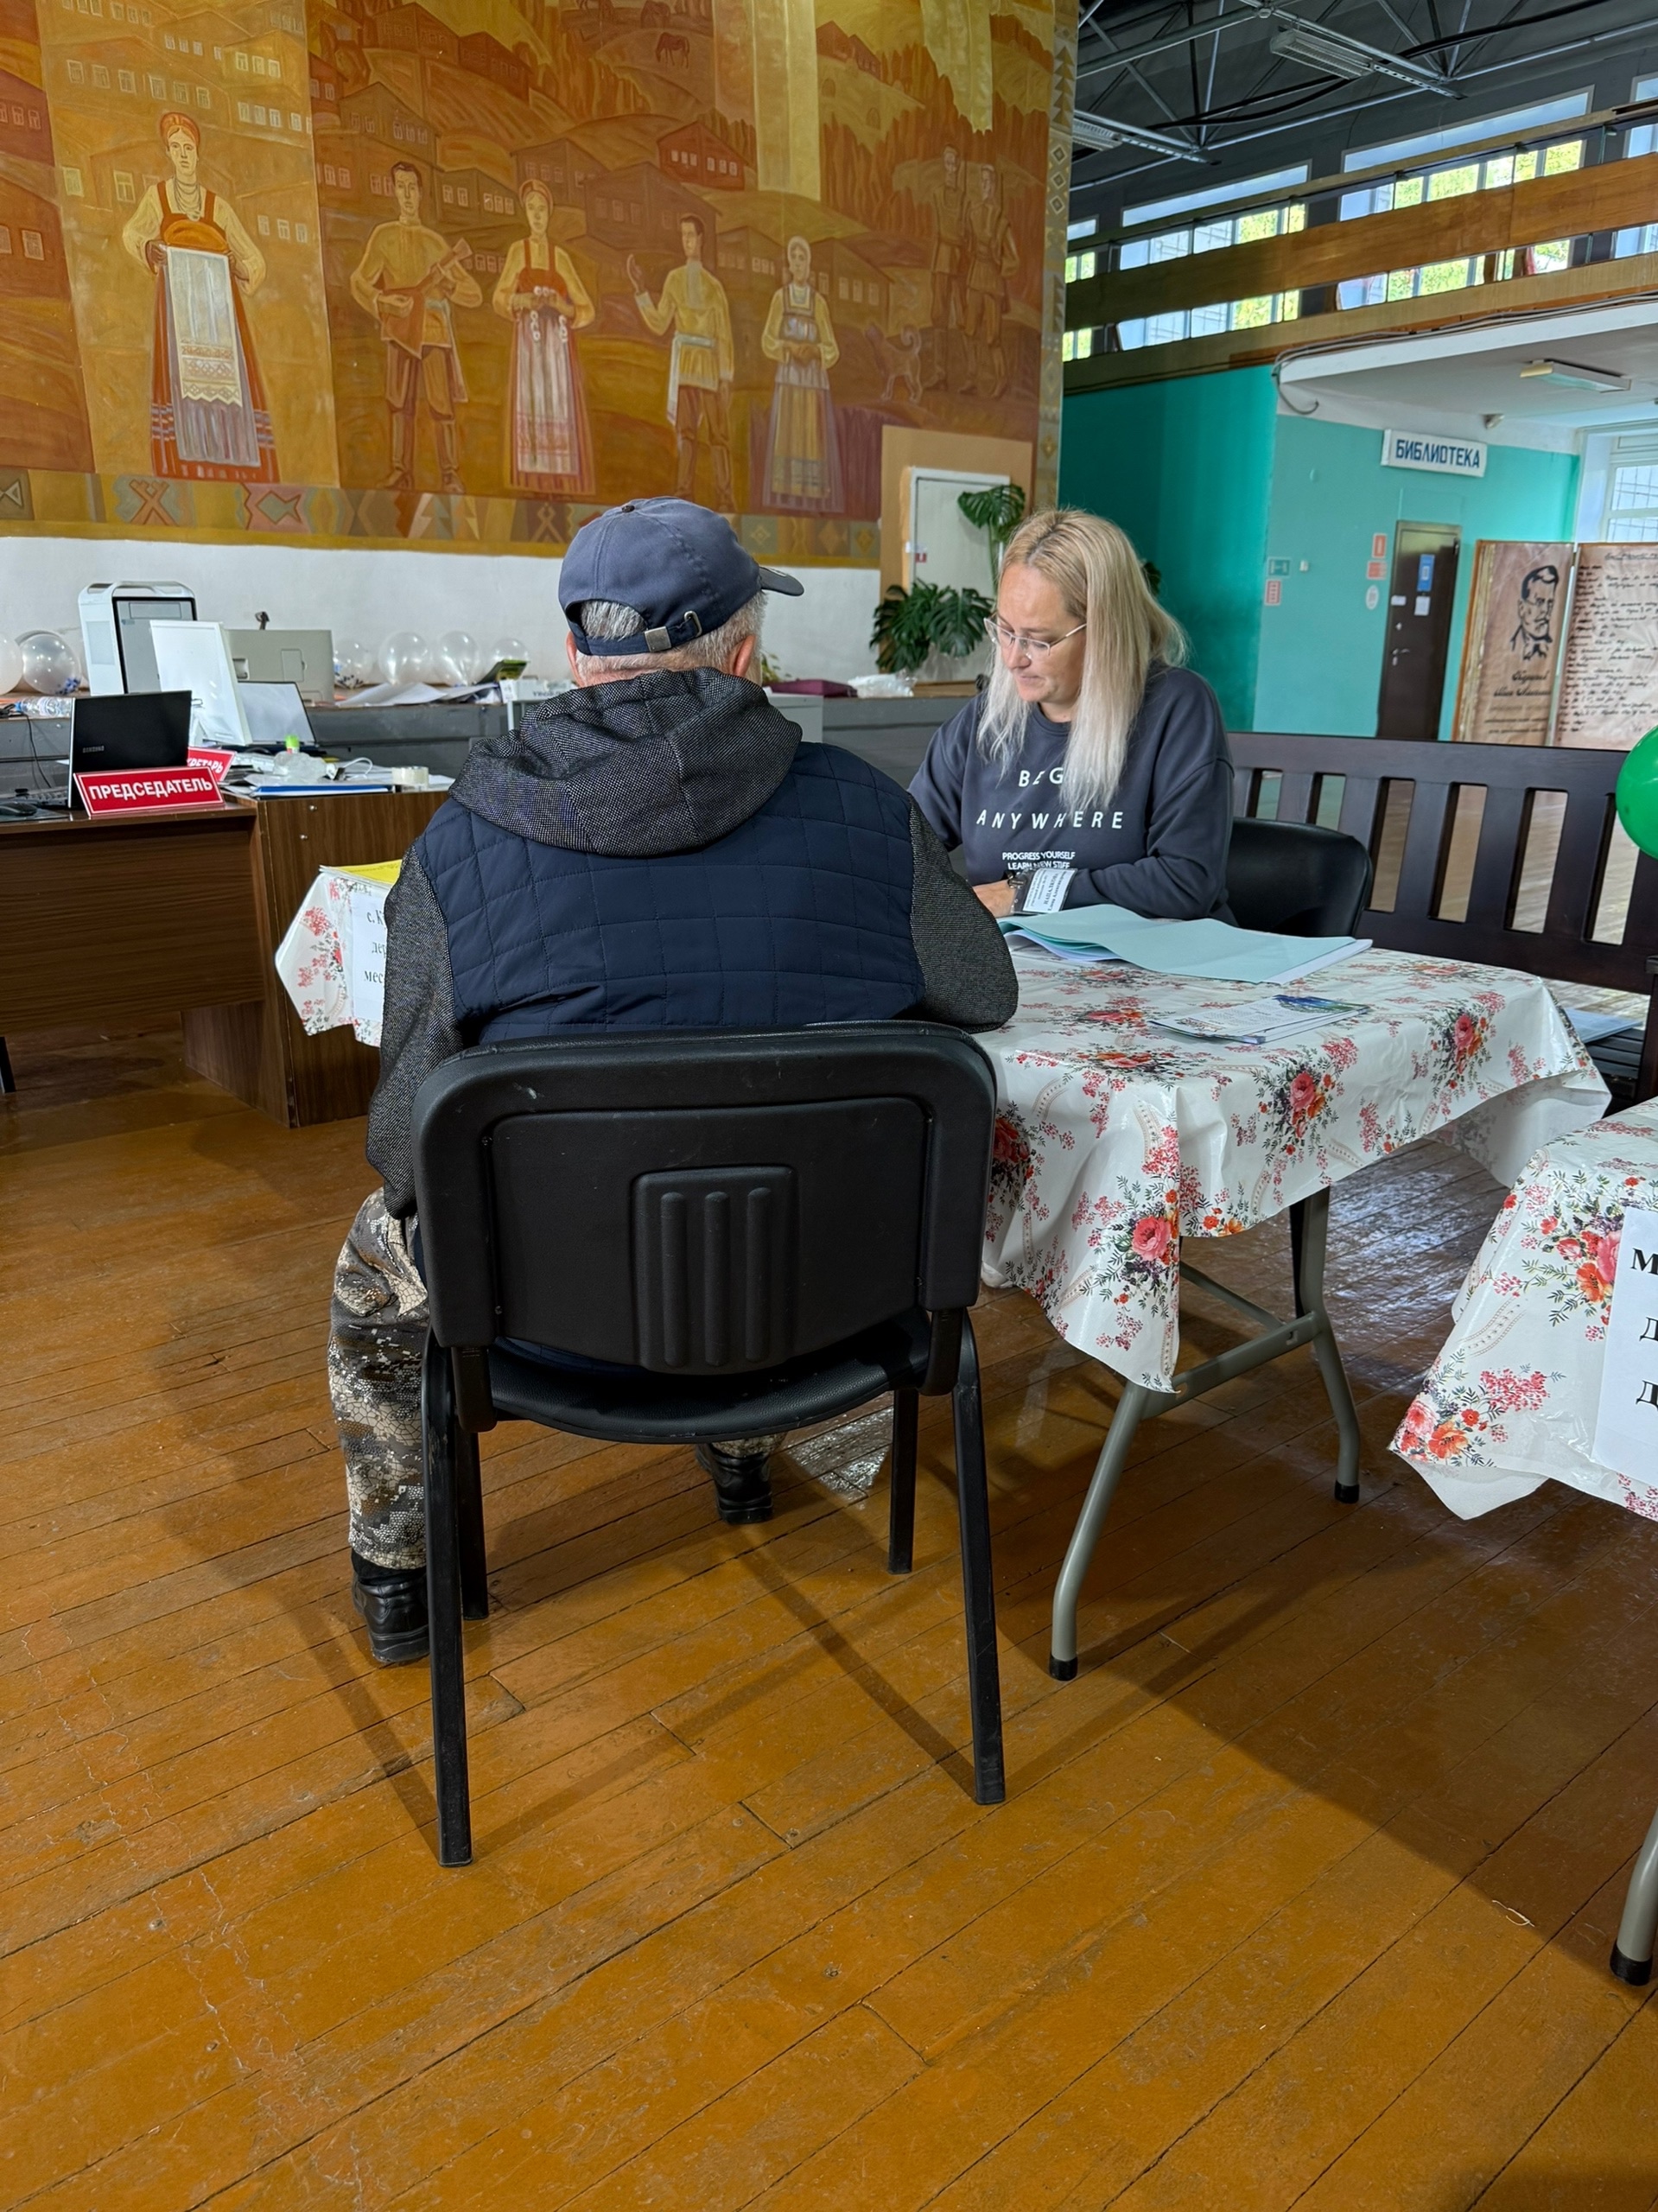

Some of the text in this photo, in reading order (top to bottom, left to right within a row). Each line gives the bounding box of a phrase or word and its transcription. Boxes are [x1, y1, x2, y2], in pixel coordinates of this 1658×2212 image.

[1395, 439, 1479, 468] БИБЛИОТЕКА
[1019, 767, 1064, 787] BEG
[88, 778, 213, 801] ПРЕДСЕДАТЕЛЬ
[976, 810, 1123, 830] ANYWHERE
[1002, 850, 1076, 861] PROGRESS YOURSELF
